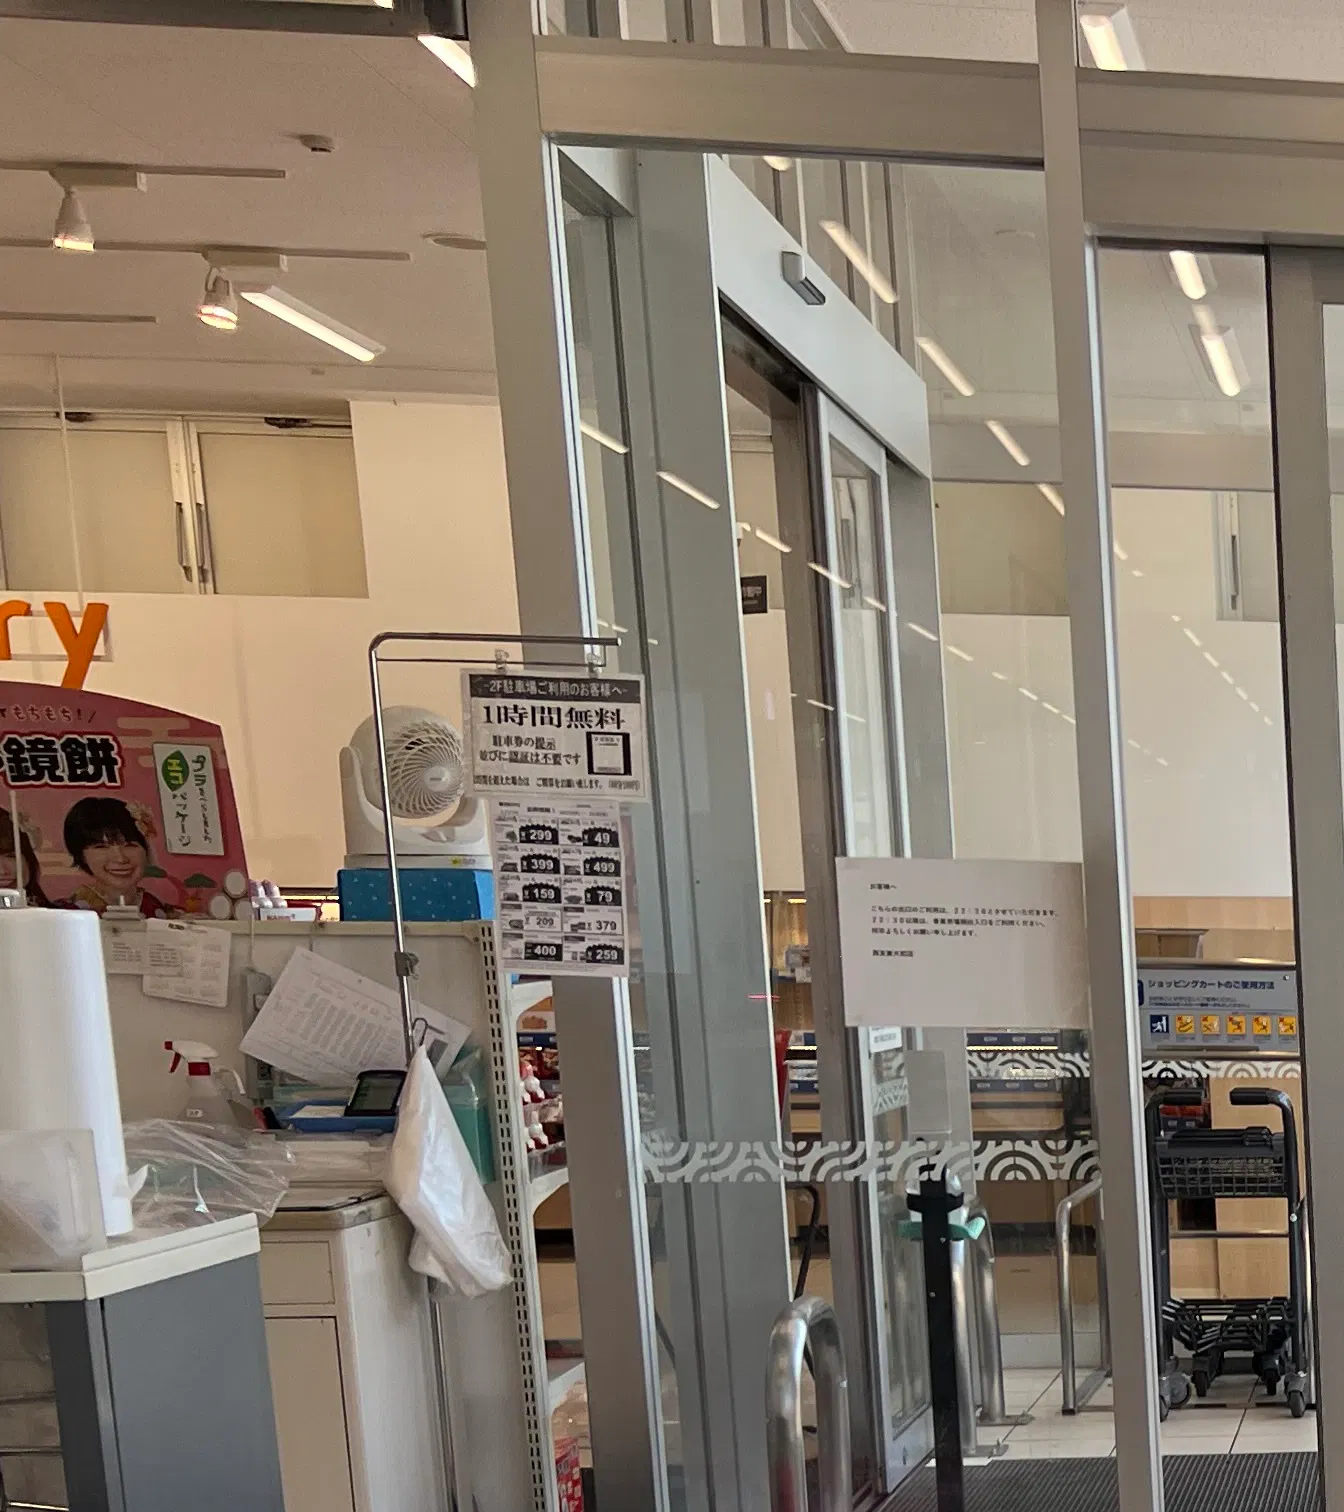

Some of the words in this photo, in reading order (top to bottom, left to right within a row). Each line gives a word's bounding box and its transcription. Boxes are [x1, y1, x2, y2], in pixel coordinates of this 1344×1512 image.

[483, 704, 626, 730] 1時間無料
[0, 736, 120, 783] 鏡餅
[529, 828, 552, 841] 299
[533, 887, 555, 900] 159
[595, 920, 617, 931] 379
[533, 945, 557, 957] 400
